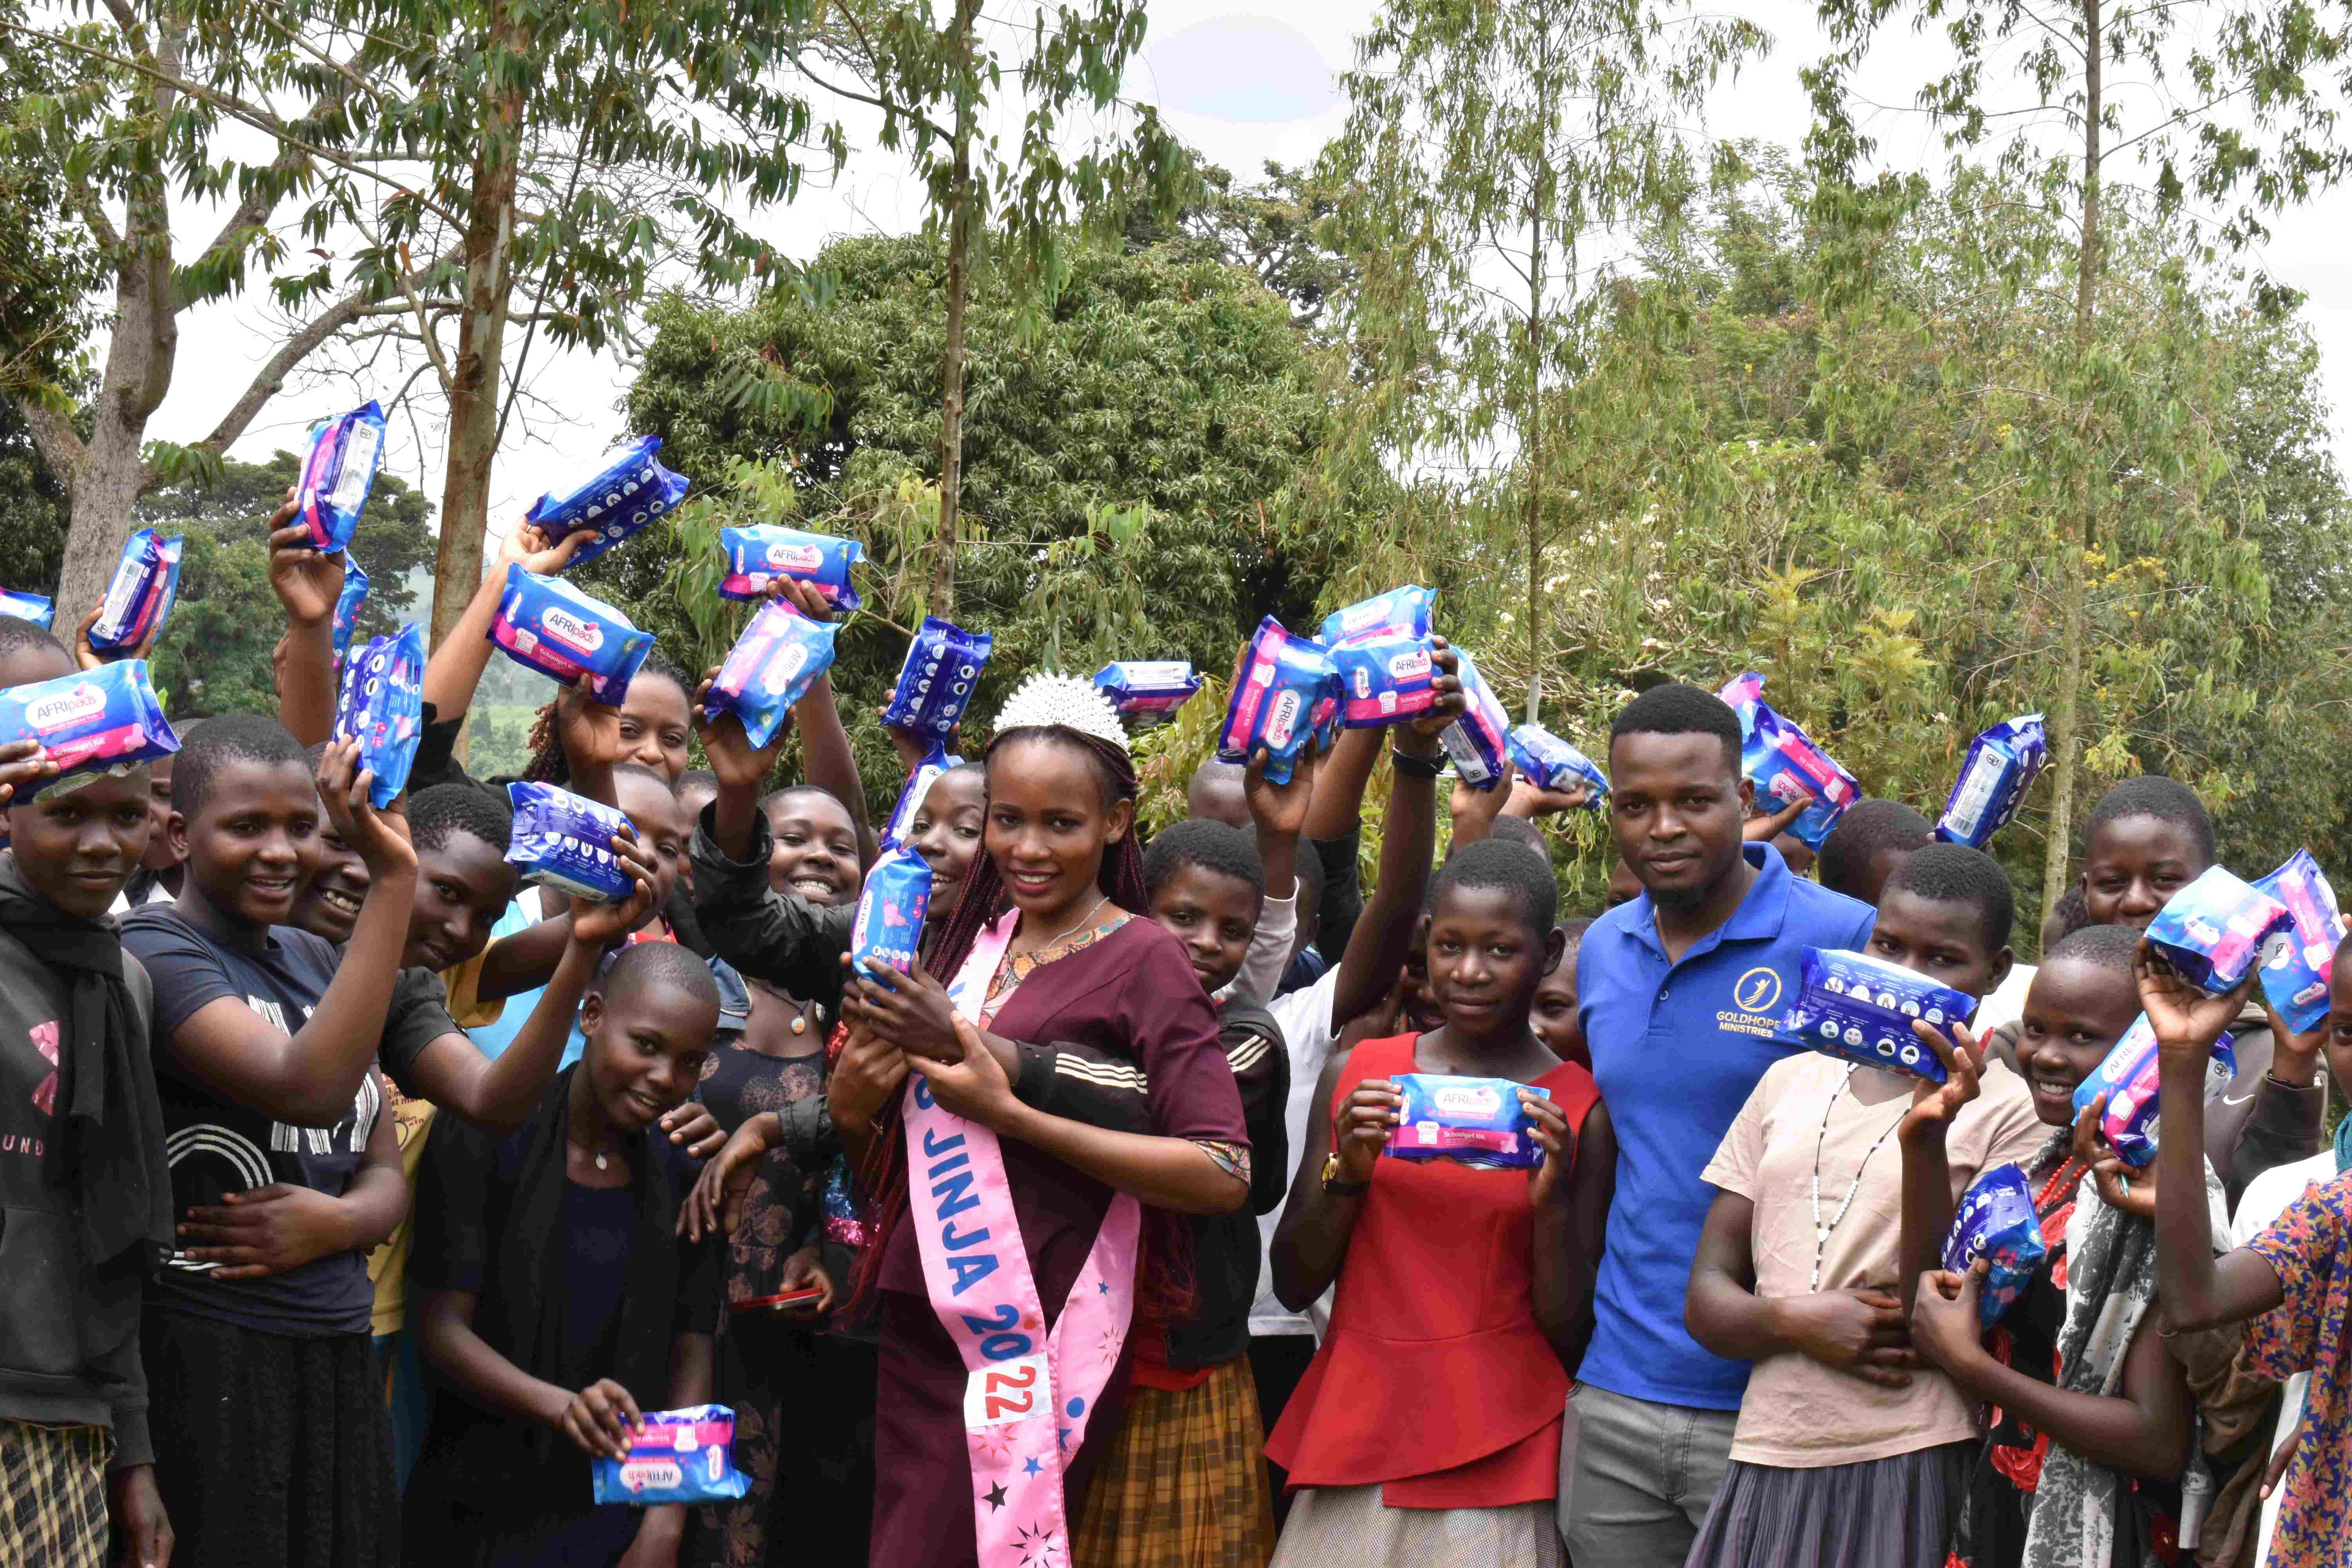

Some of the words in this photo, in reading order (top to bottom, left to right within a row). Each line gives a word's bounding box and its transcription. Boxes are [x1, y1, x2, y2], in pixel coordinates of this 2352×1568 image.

[773, 549, 816, 563] AFRIpads
[550, 614, 595, 643] AFRIpads
[539, 648, 567, 667] Schoolgirl
[1396, 656, 1428, 671] AFRIpads
[38, 694, 96, 720] AFRIpads
[1273, 696, 1295, 740] AFRIpads
[53, 740, 93, 757] Schoolgirl
[94, 738, 106, 746] Kit
[1716, 1011, 1781, 1029] GOLDHOPE
[1719, 1022, 1773, 1038] MINISTRIES
[1443, 1093, 1493, 1108] AFRIpads
[1443, 1131, 1474, 1139] Schoolgirl
[923, 1127, 1000, 1297] JINJA
[628, 1467, 673, 1482] AFRIpads
